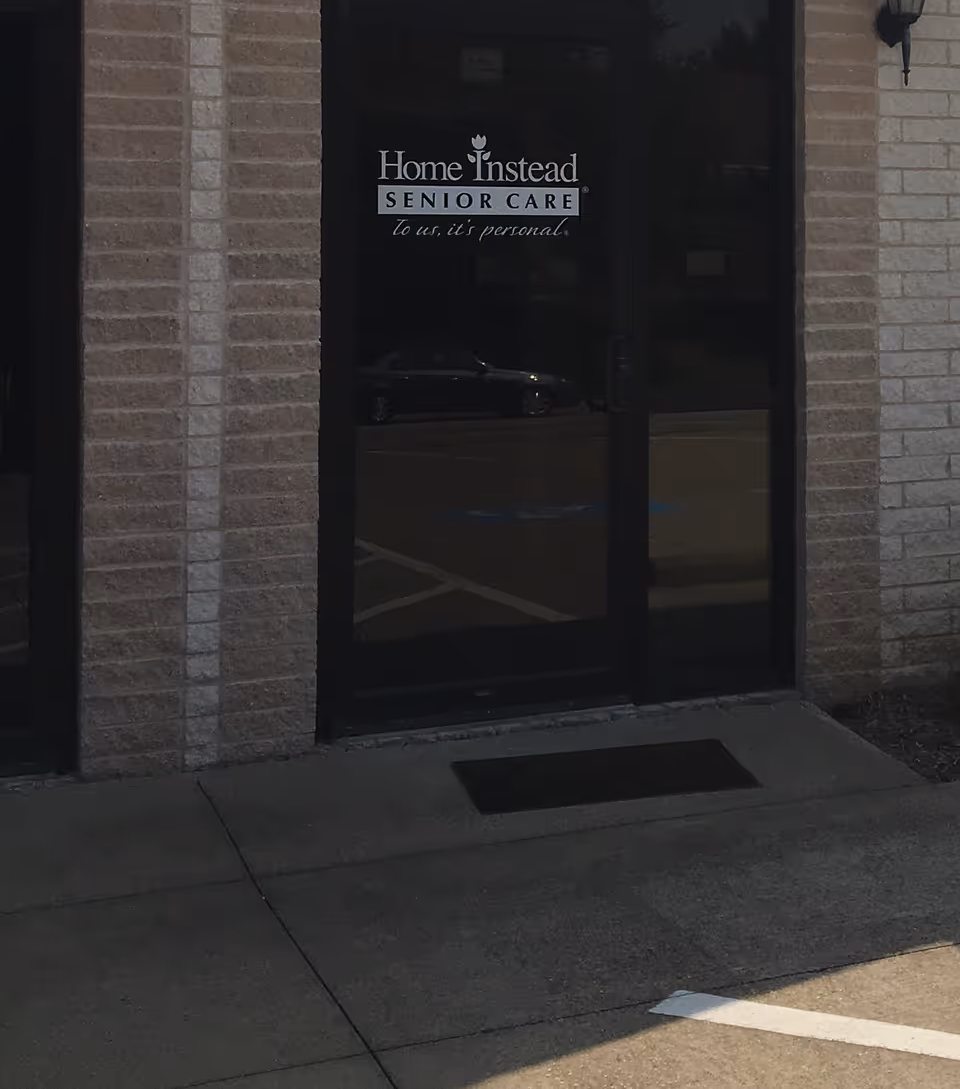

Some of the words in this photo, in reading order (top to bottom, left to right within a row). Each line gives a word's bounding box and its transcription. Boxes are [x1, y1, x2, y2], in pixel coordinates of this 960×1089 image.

[377, 150, 464, 182] Home
[472, 150, 579, 183] Instead
[385, 191, 493, 209] SENIOR
[505, 192, 573, 210] CARE
[392, 218, 411, 236] To
[416, 225, 442, 238] us,
[447, 218, 476, 237] it's
